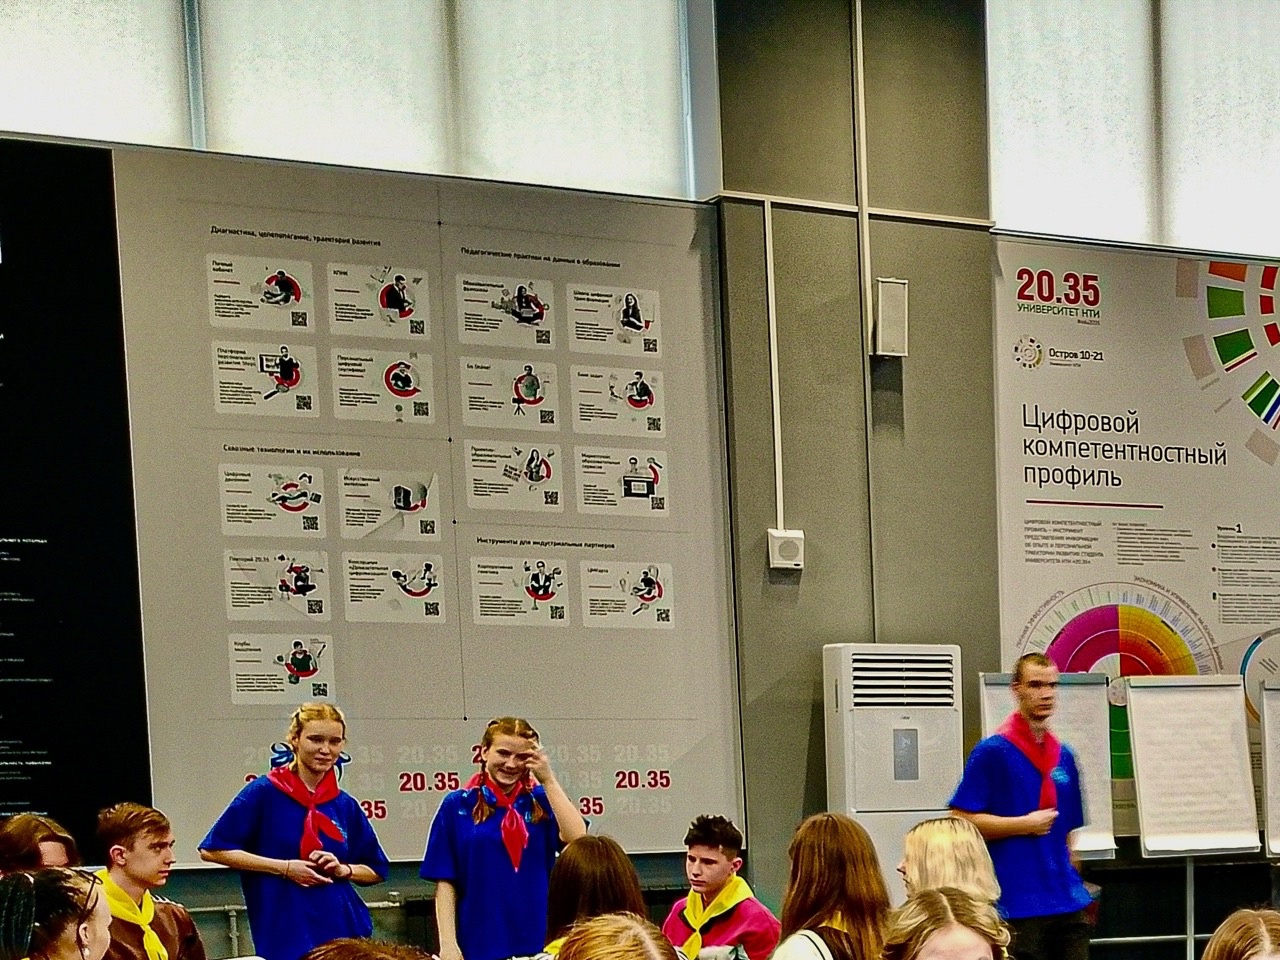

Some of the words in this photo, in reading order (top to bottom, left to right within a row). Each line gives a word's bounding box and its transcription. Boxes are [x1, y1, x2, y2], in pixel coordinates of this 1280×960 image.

[1015, 267, 1101, 307] 20.35
[1016, 303, 1079, 317] УНИВЕРСИТЕТ
[1081, 308, 1100, 319] НТИ
[1048, 348, 1079, 360] Остров
[1080, 350, 1104, 361] 10-21
[1022, 404, 1139, 434] Цифровой
[1023, 438, 1228, 465] компетентностный
[1024, 465, 1122, 490] профиль
[399, 772, 460, 792] 20.35
[615, 770, 671, 789] 20.35
